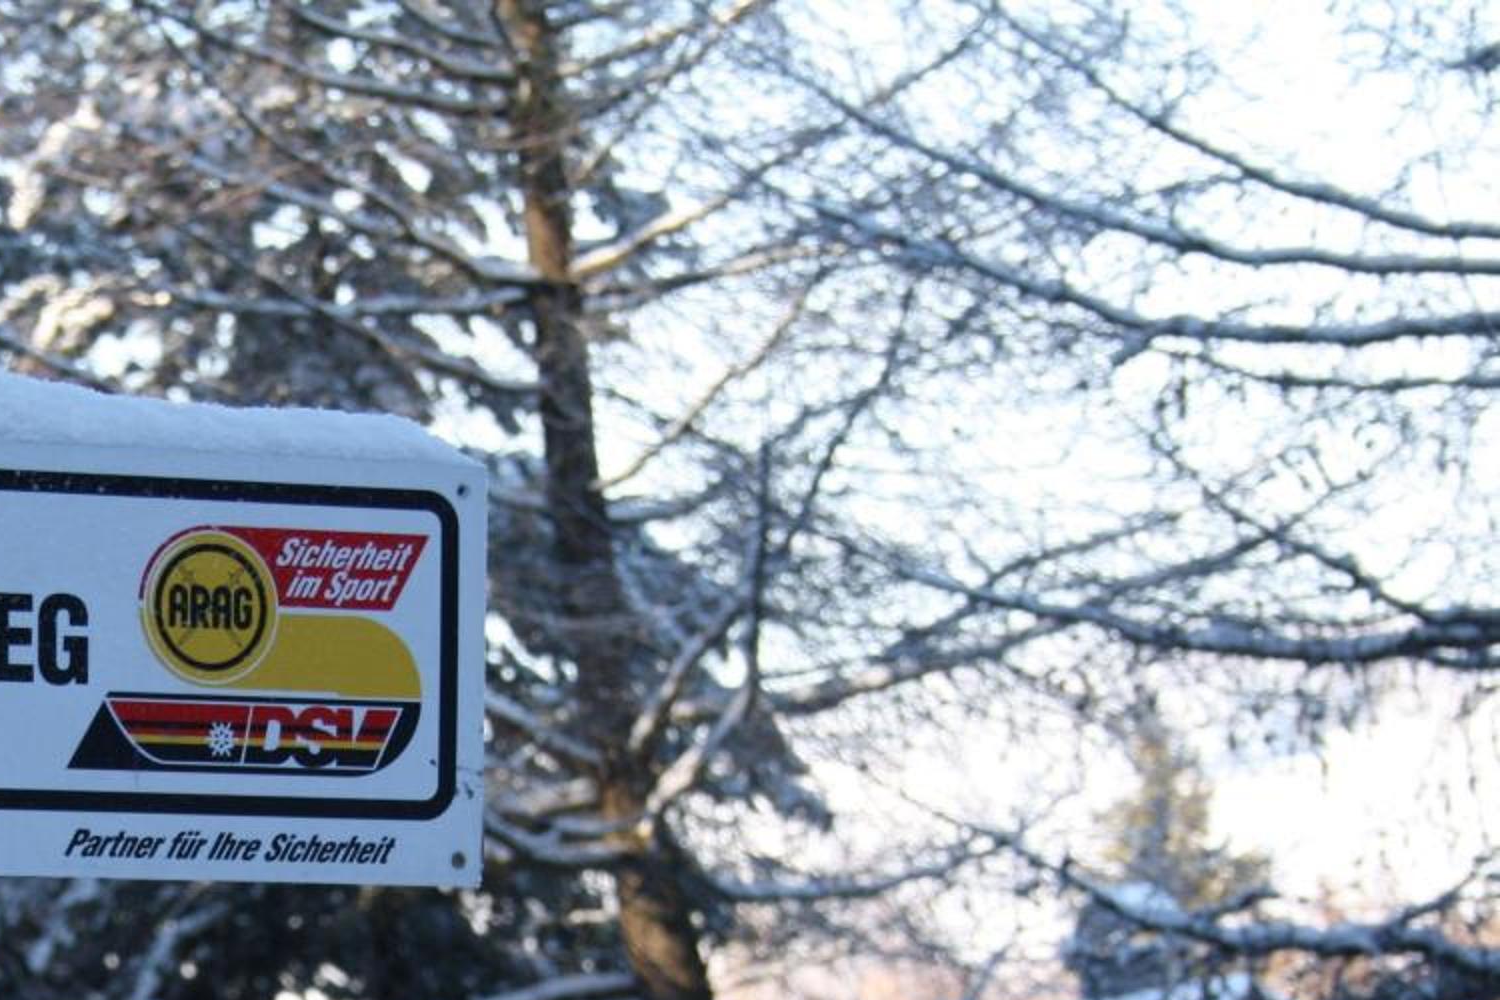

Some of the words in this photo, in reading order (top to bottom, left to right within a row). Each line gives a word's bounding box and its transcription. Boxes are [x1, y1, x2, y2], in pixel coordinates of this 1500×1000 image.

[276, 537, 412, 572] Sicherheit
[167, 582, 253, 631] ARAG
[287, 571, 320, 600] im
[322, 570, 398, 607] Sport
[245, 704, 400, 770] DSV
[65, 828, 164, 859] Partner
[165, 831, 207, 862] für
[208, 832, 263, 862] Ihre
[264, 833, 396, 866] Sicherheit
